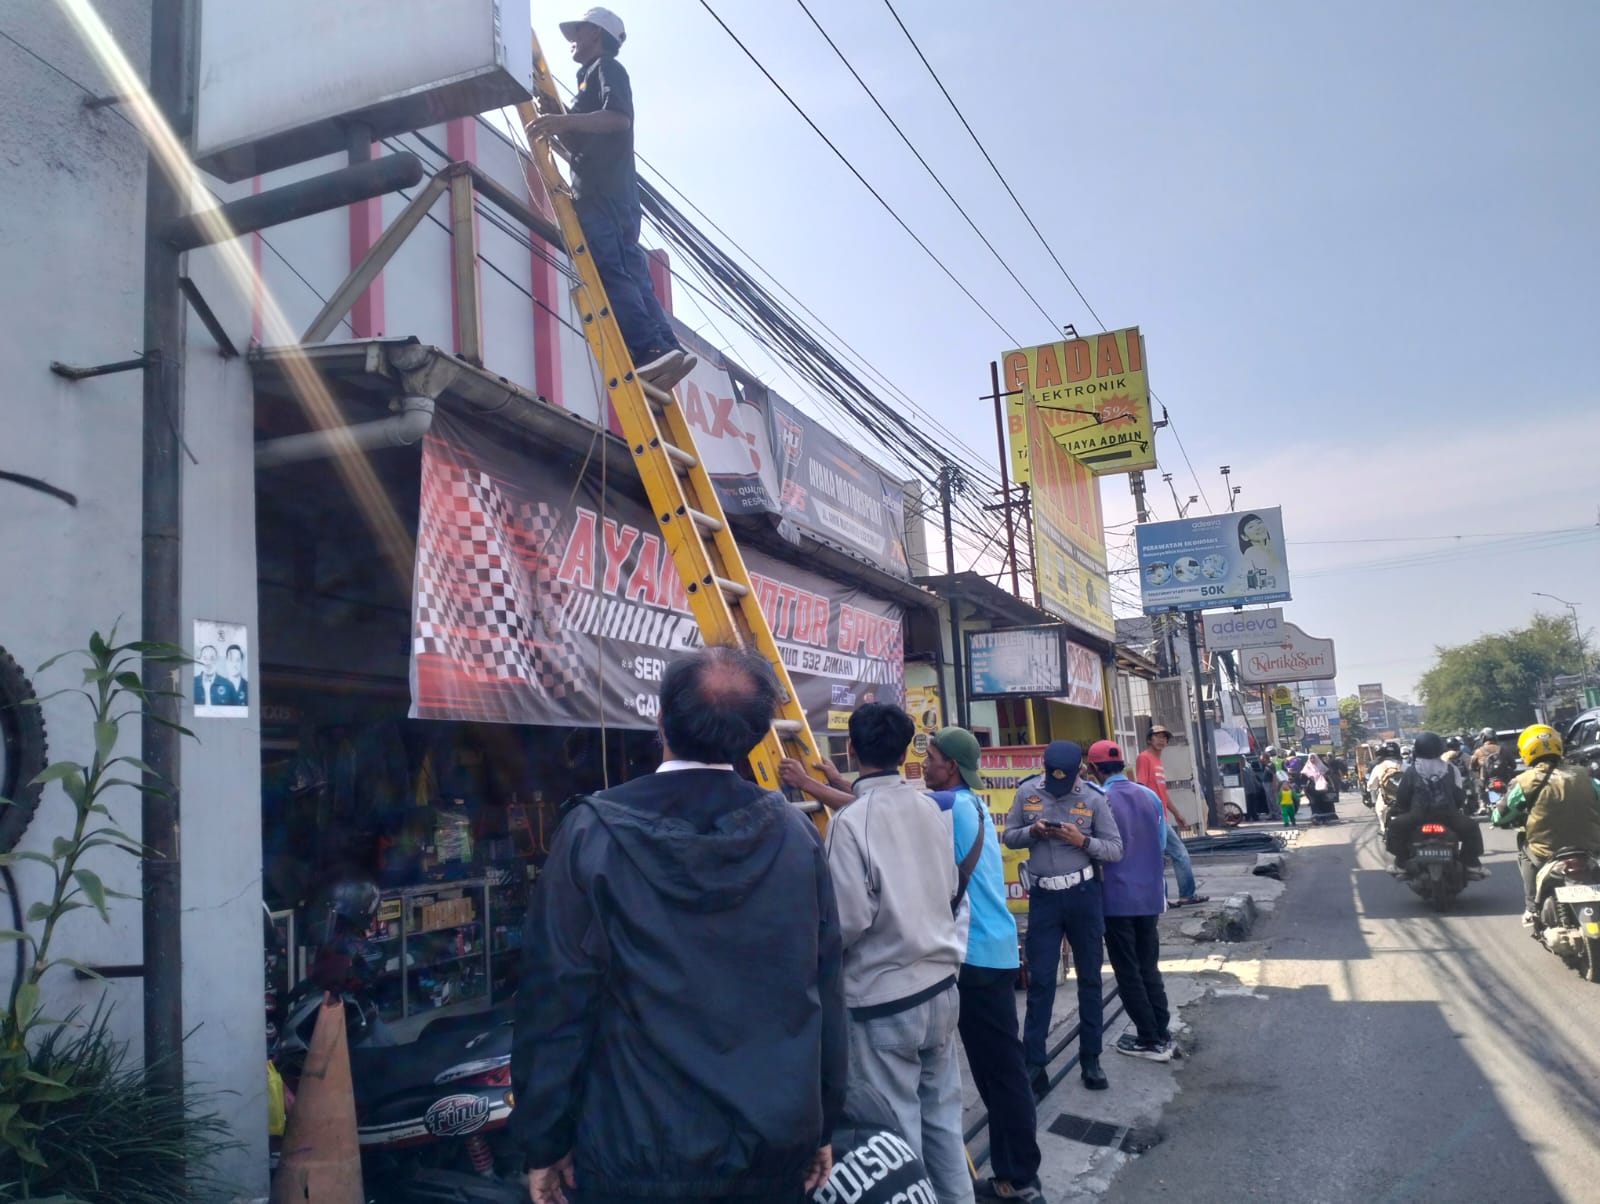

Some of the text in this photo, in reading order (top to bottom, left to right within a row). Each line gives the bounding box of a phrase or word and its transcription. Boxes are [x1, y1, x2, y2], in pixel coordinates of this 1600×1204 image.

[1004, 328, 1142, 392] GADAI
[1022, 379, 1126, 404] LEKTRONIK
[1008, 403, 1130, 434] BNGA 5%
[1100, 430, 1142, 446] ADMIN
[1201, 585, 1225, 597] 50K
[750, 571, 830, 648] OTOR
[1211, 617, 1277, 634] adeeva
[803, 652, 821, 671] 532
[823, 656, 854, 676] CIMAHI
[1297, 713, 1329, 728] GADAI
[427, 1097, 489, 1135] Fino
[812, 1131, 918, 1204] POISON
